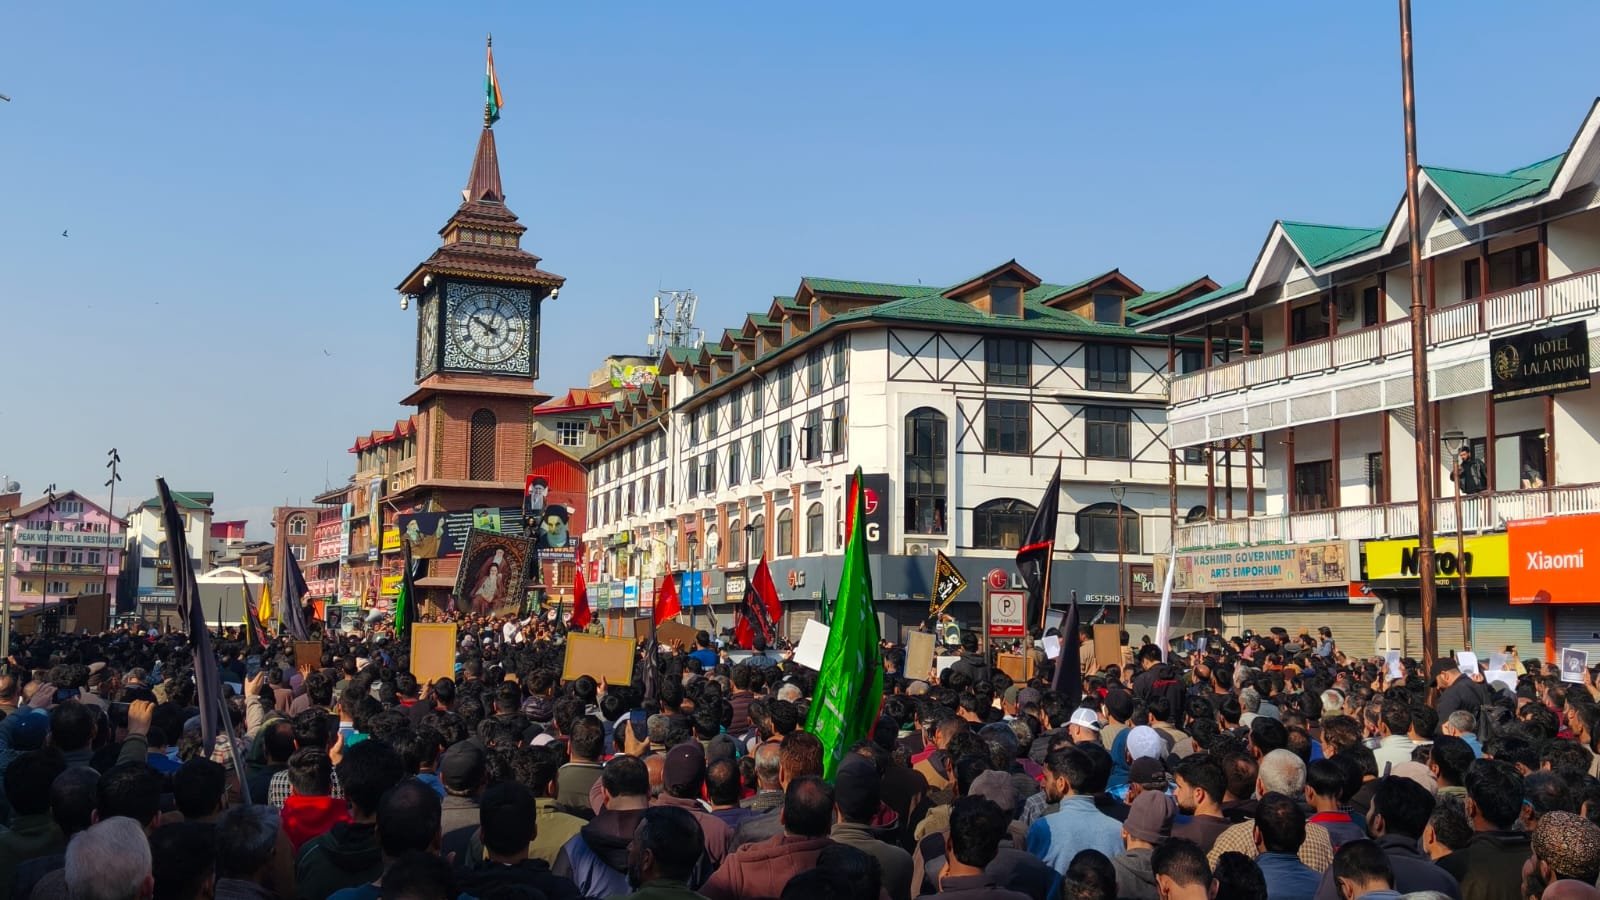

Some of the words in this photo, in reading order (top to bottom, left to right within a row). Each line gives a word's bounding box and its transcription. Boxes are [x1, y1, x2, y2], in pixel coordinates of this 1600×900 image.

[1534, 337, 1570, 356] HOTEL
[1552, 353, 1585, 371] RUKH
[18, 532, 36, 542] PEAK
[54, 534, 75, 543] HOTEL
[76, 536, 82, 544] &
[83, 536, 123, 545] RESTAUANT
[1193, 551, 1232, 567] KASHMIR
[1235, 548, 1297, 564] GOVERNMENT
[1526, 548, 1584, 571] Xiaomi
[1210, 567, 1231, 579] ARTS
[1233, 564, 1282, 578] EMPORIUM
[1003, 599, 1011, 613] P
[1085, 594, 1103, 602] BEST
